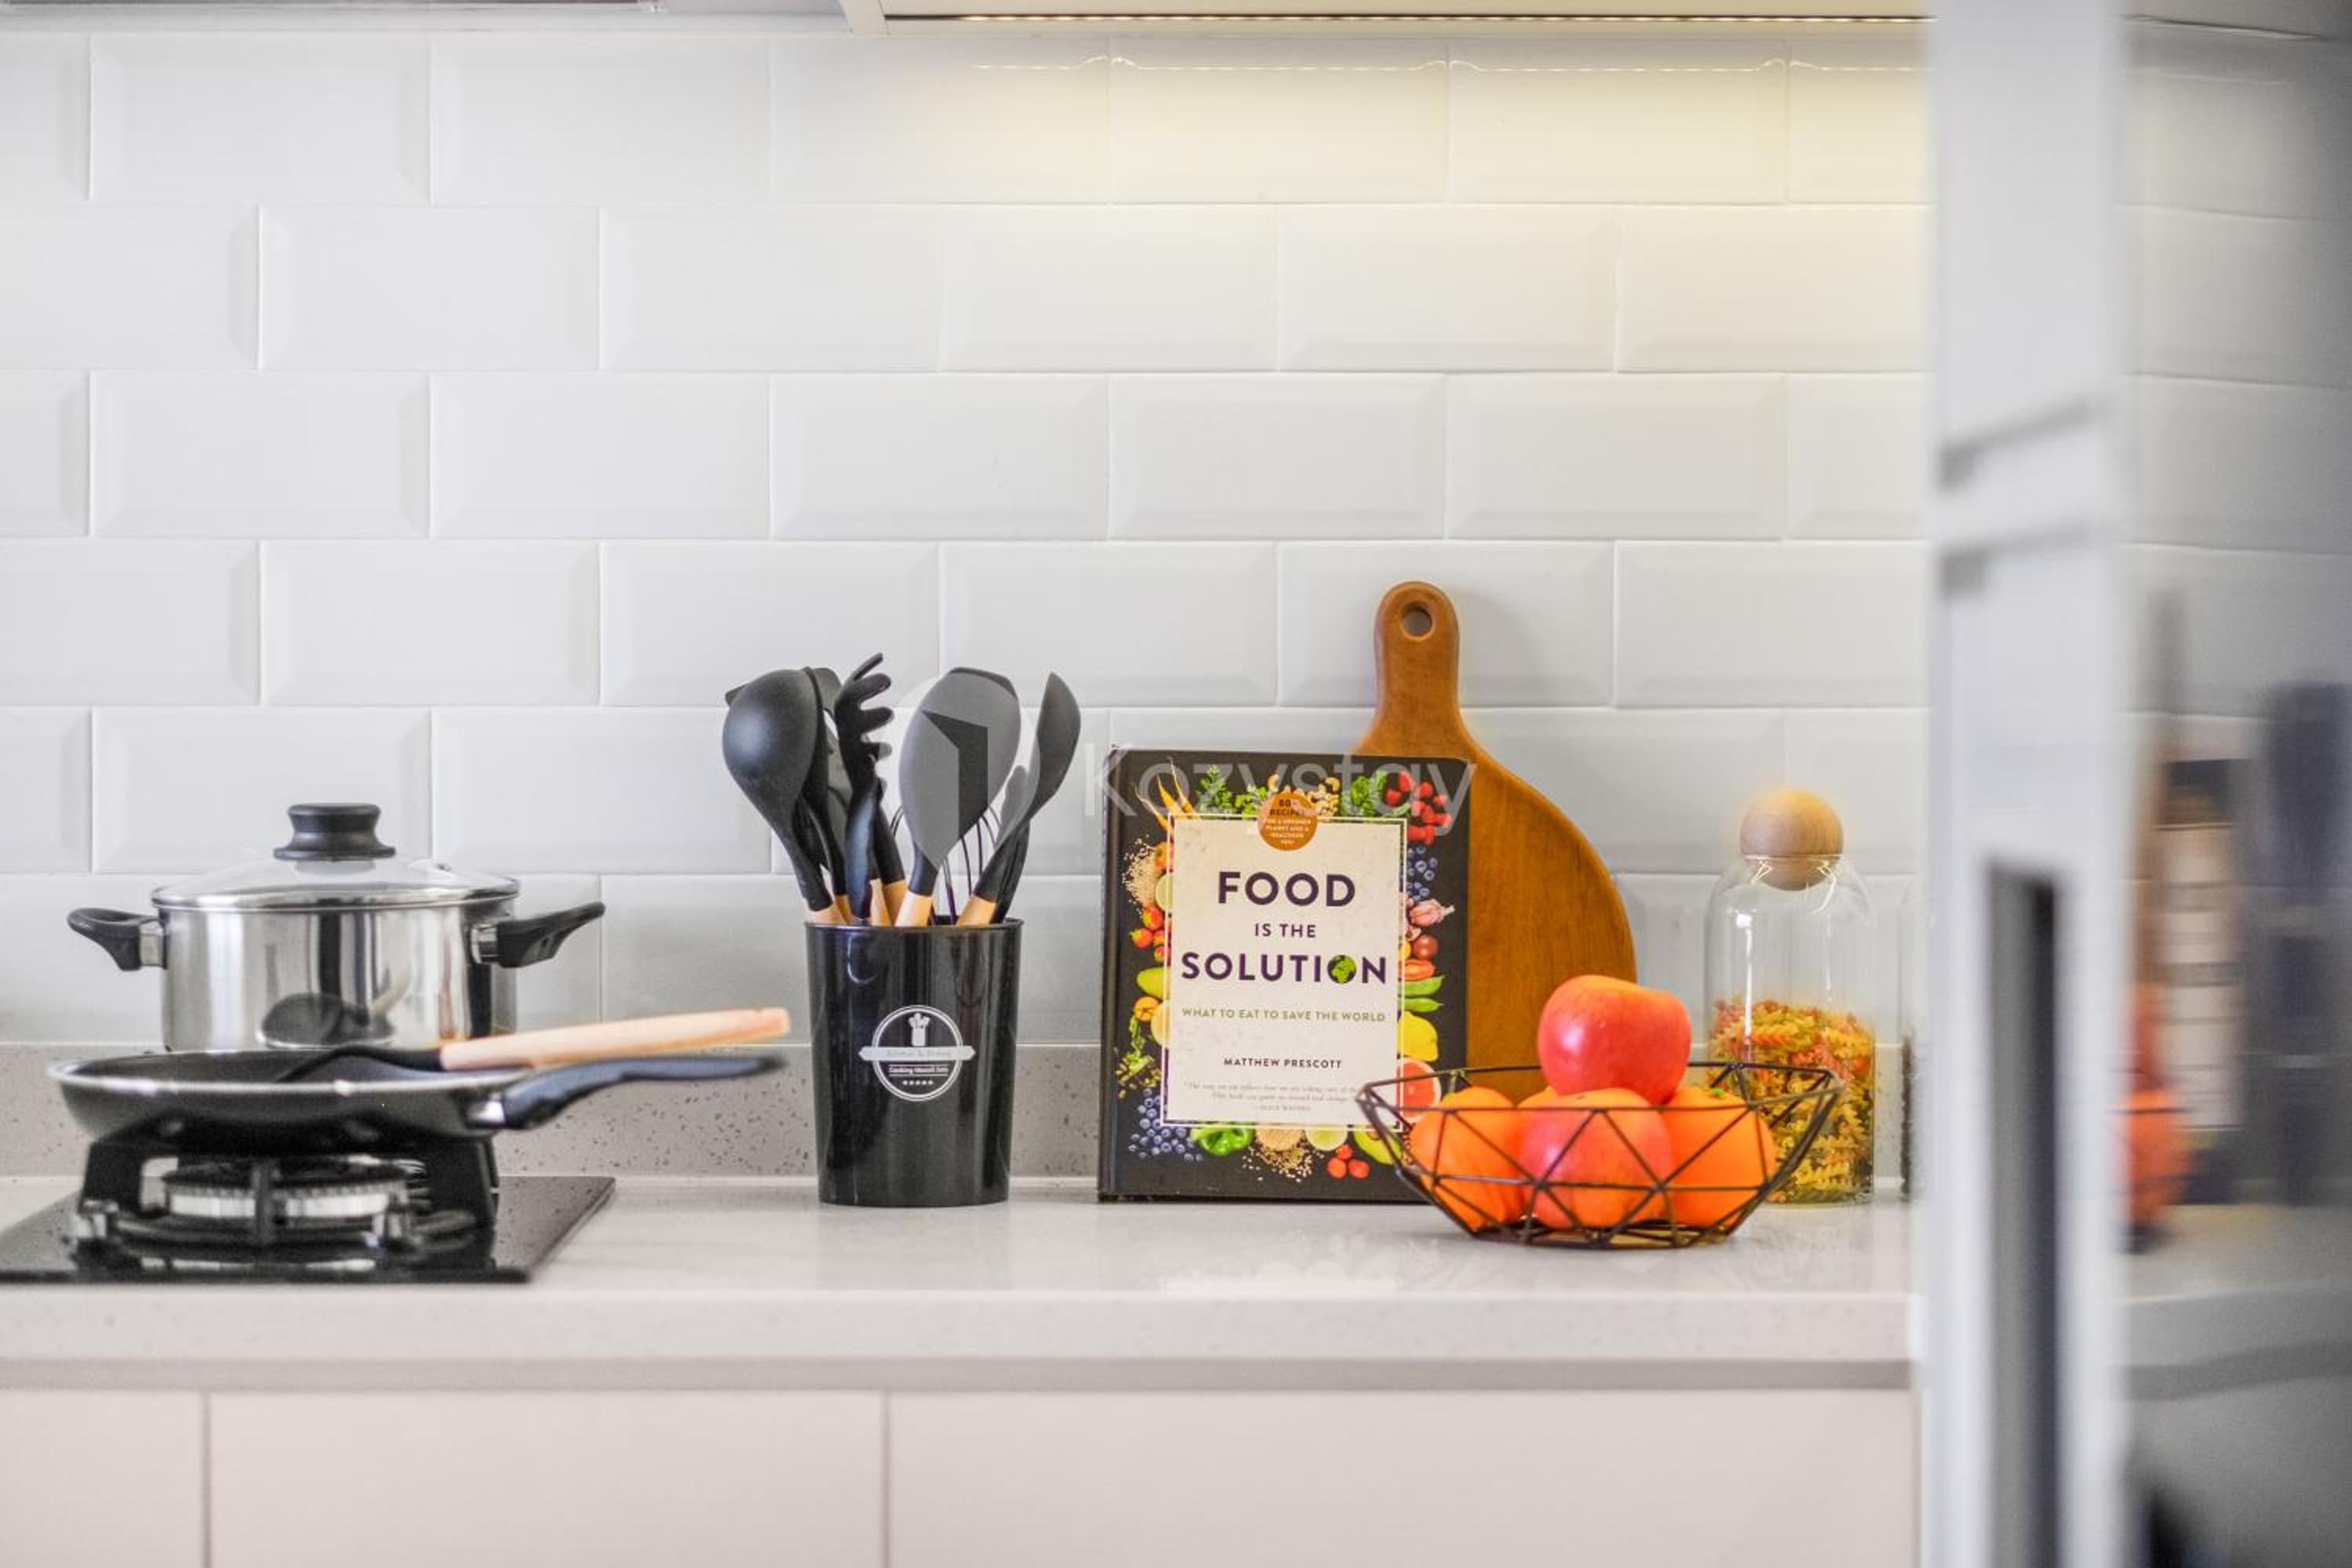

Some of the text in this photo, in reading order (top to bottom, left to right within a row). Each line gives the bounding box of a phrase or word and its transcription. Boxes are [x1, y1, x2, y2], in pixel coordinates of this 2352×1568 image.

[1218, 871, 1356, 907] FOOD
[1254, 923, 1316, 938] IS THE
[1181, 952, 1386, 985] SOLUTION
[1182, 1008, 1385, 1022] WHAT TO EAT TO SAVE THE WORLD
[1224, 1058, 1342, 1069] MATTHEW PRESCOTT
